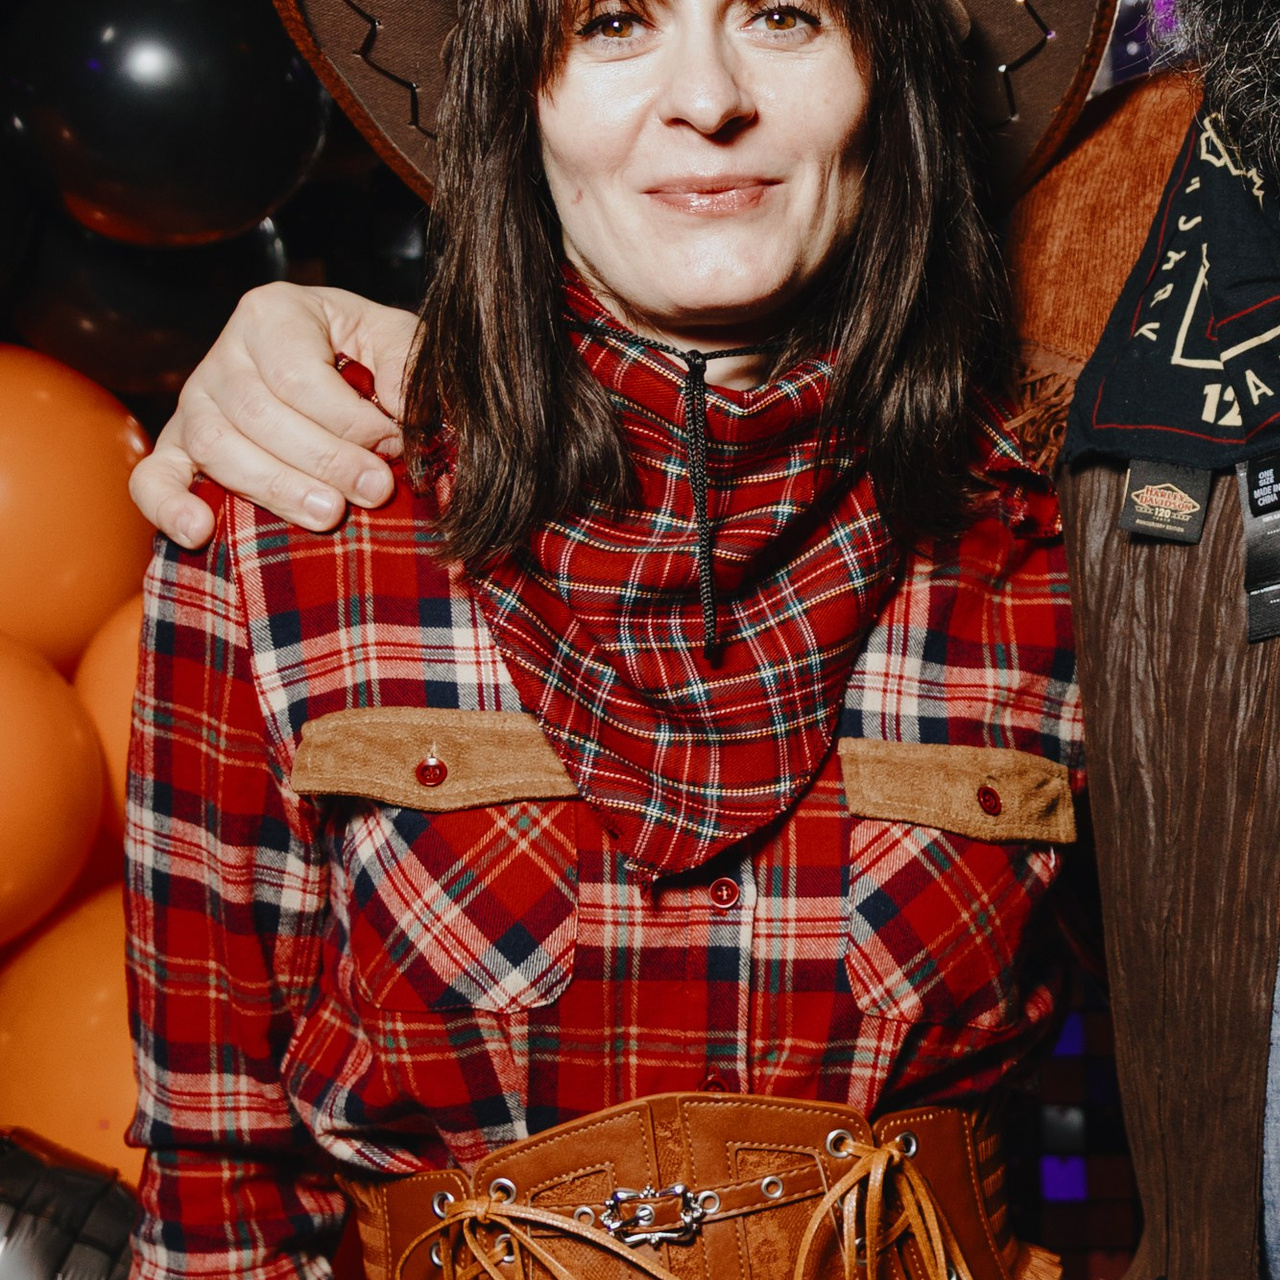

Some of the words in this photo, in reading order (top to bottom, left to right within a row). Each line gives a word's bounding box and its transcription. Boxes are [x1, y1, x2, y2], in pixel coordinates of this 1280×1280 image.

[1258, 468, 1274, 480] ONE
[1258, 477, 1275, 487] SIZE
[1253, 484, 1272, 499] MADE
[1257, 493, 1279, 507] CHINA
[1154, 507, 1172, 519] 120
